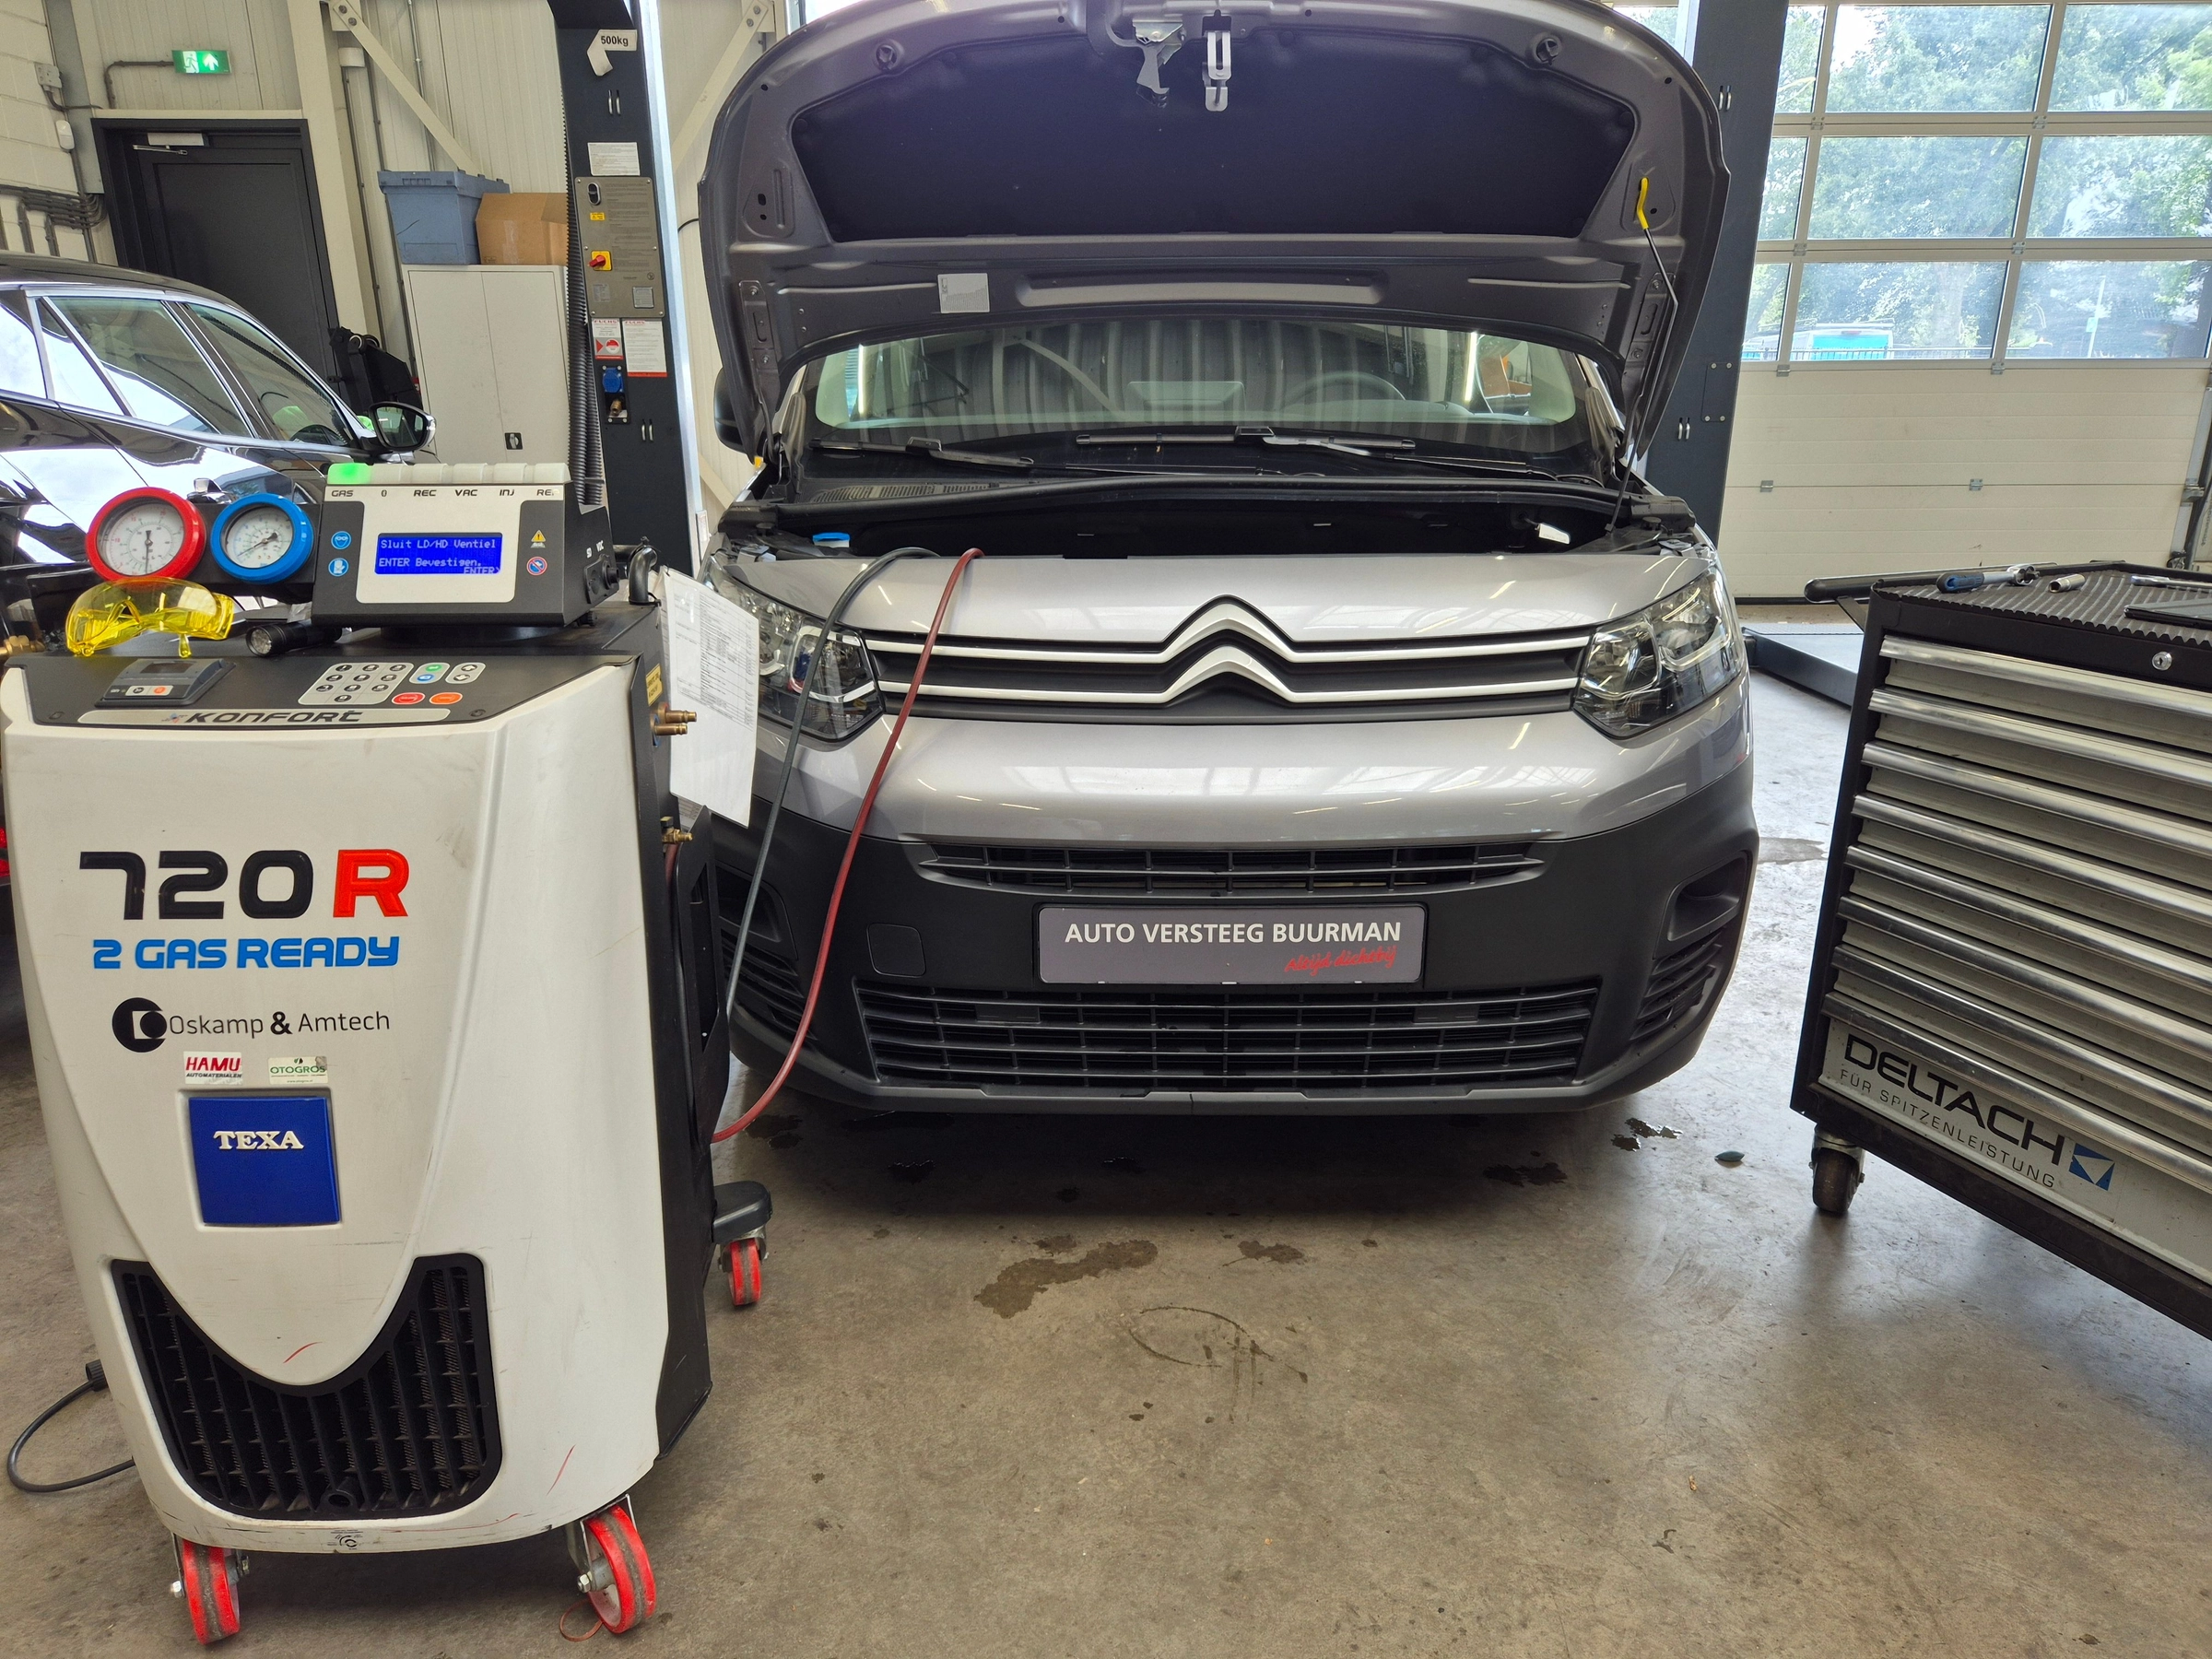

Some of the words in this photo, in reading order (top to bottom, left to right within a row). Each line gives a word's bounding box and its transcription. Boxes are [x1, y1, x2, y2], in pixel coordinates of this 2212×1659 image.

[601, 36, 629, 47] 500kg
[331, 489, 354, 498] GAS
[454, 488, 478, 497] VAC
[380, 539, 412, 549] Sluit
[417, 539, 449, 548] LD/HD
[453, 538, 497, 549] Ventiel
[379, 558, 410, 567] ENTER
[185, 712, 363, 723] KONFORT
[1065, 924, 1135, 943] AUTO
[1142, 923, 1264, 943] VERSTEEG
[1272, 922, 1401, 943] BUURMAN
[93, 939, 122, 970] 2
[135, 938, 228, 970] GAS
[236, 936, 400, 969] READY
[170, 1015, 265, 1039] Oskamp
[270, 1010, 293, 1035] &
[298, 1010, 391, 1033] Amtech
[185, 1057, 241, 1072] HAMU
[270, 1065, 327, 1075] OTOGROS
[1844, 1033, 2065, 1166] DELTACH
[1840, 1069, 1872, 1094] FÜR
[1879, 1088, 2055, 1188] SPITZENLEISTUNG
[213, 1130, 305, 1150] TEXA
